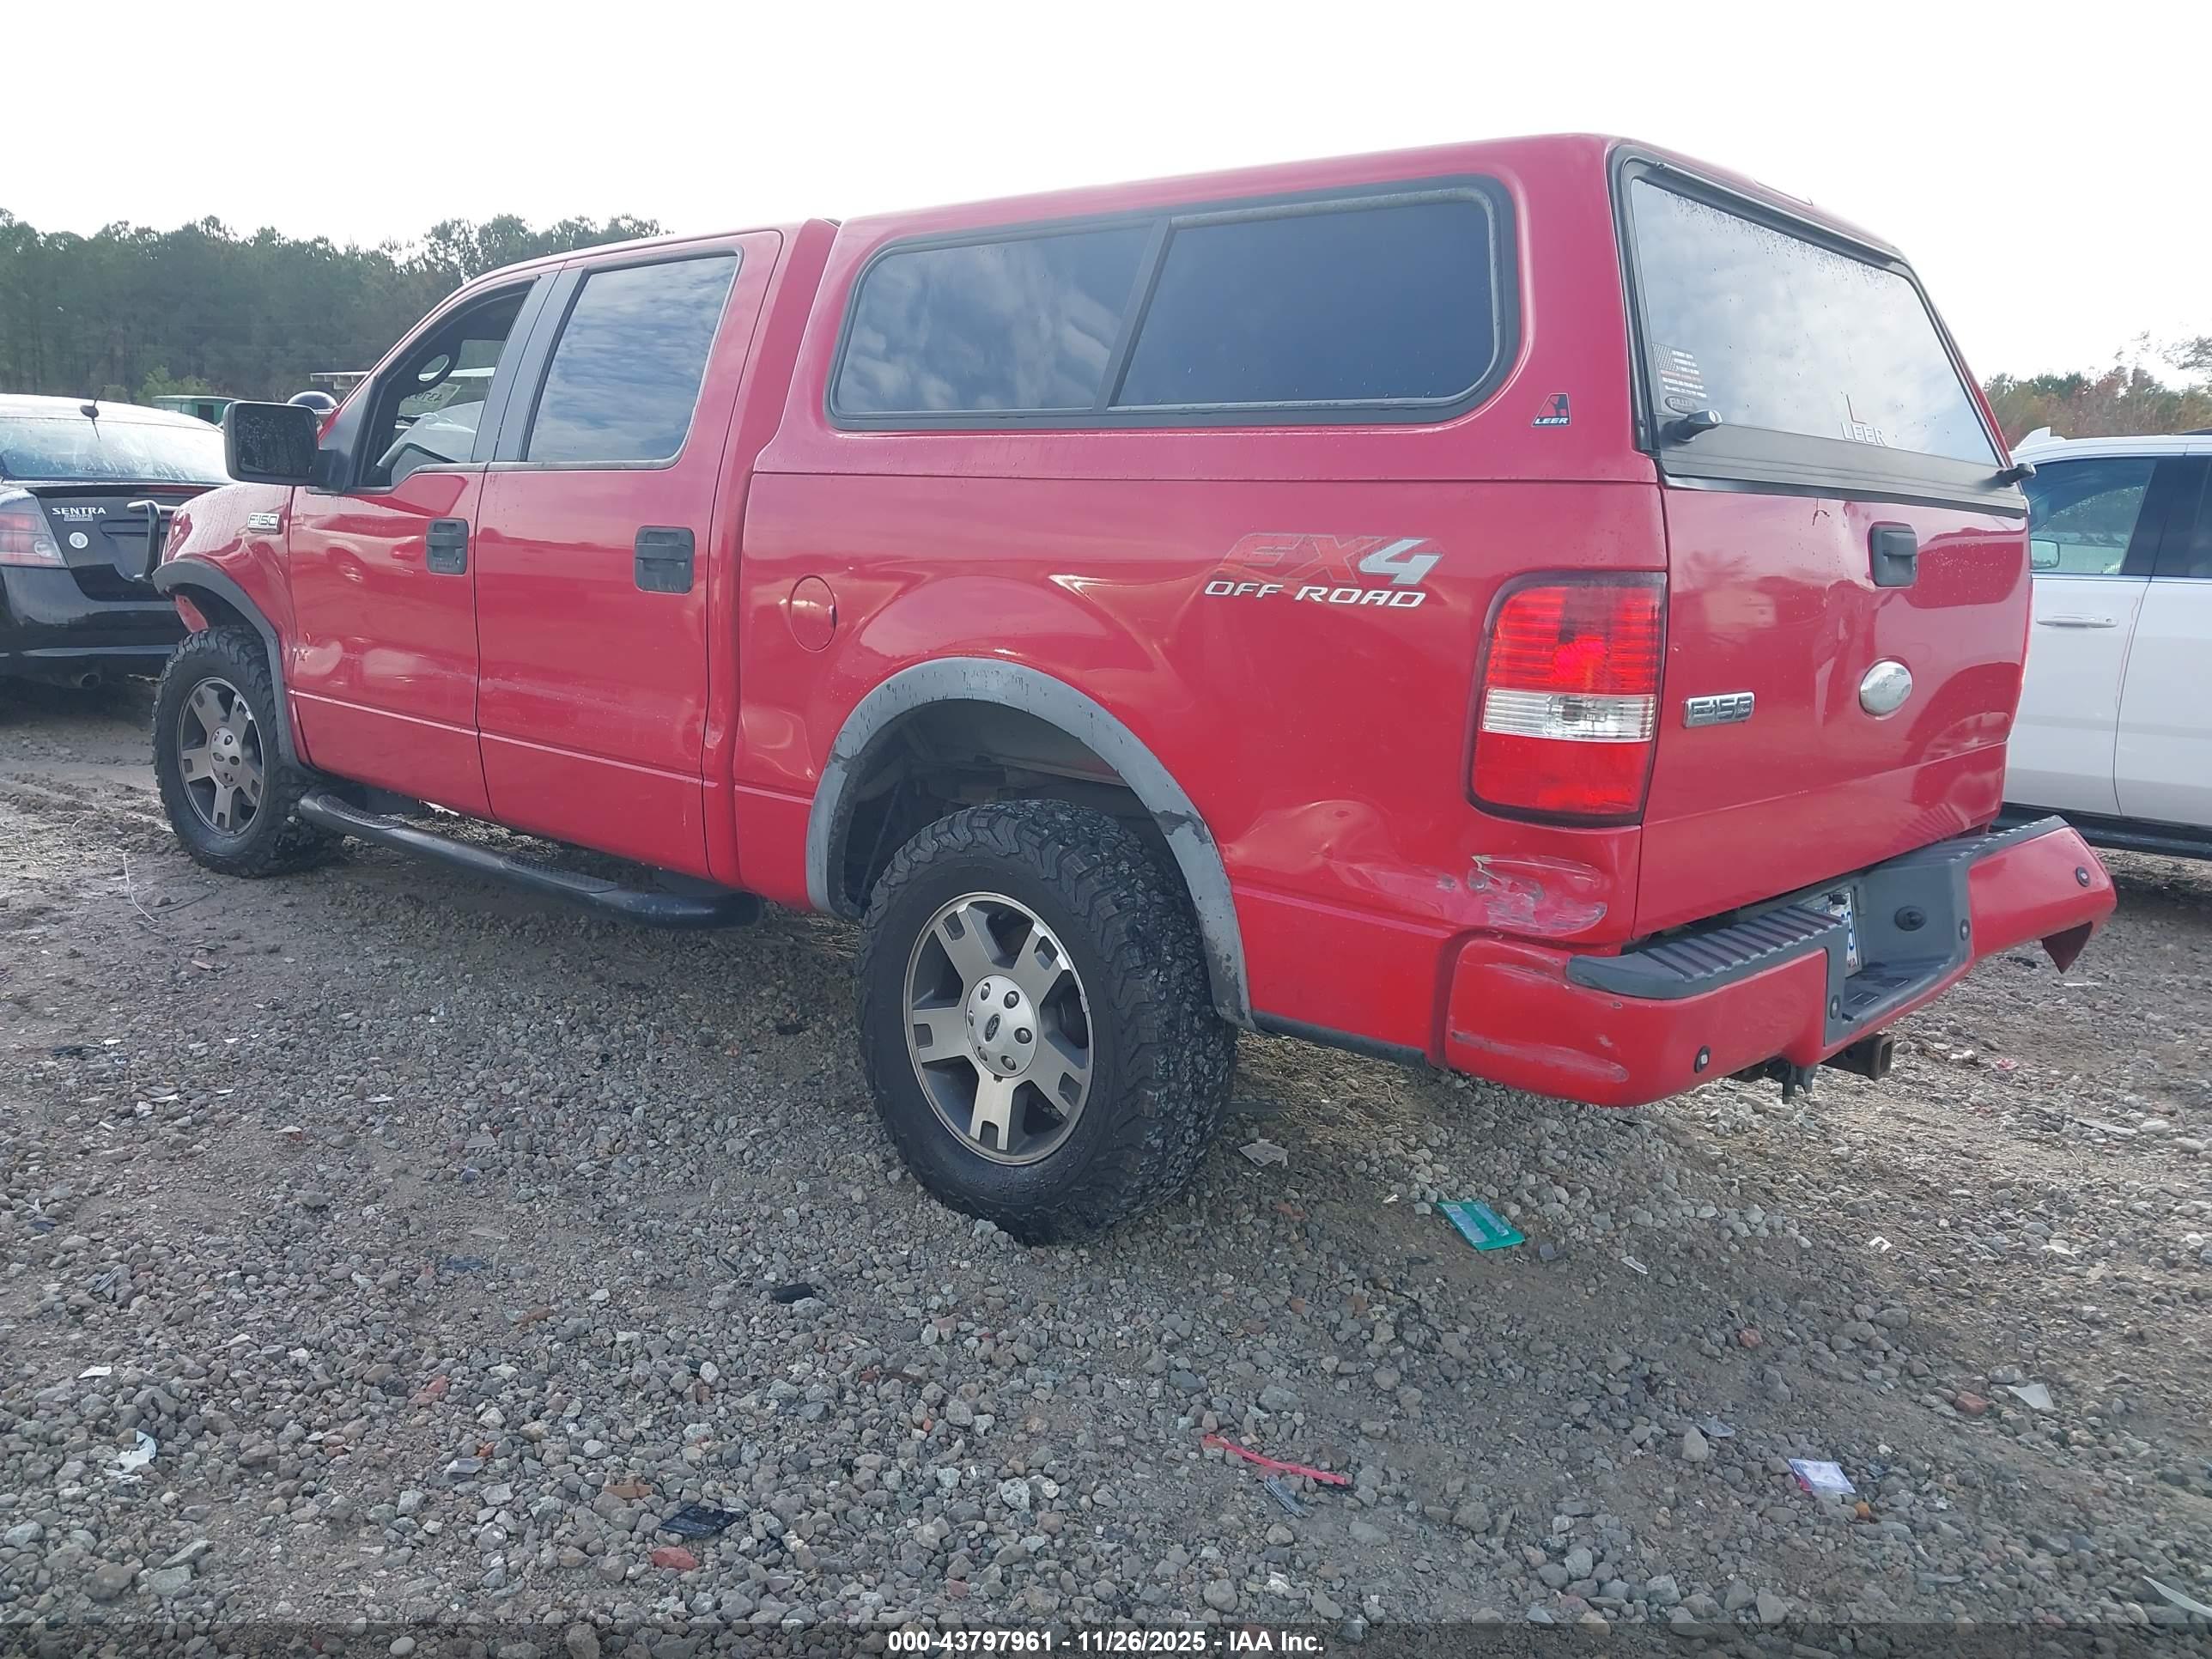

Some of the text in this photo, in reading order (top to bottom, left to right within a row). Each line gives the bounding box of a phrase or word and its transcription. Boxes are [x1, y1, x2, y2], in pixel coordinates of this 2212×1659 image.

[1840, 422, 1888, 447] LEER
[52, 507, 106, 515] SENTRA
[1204, 580, 1426, 608] OFF ROAD
